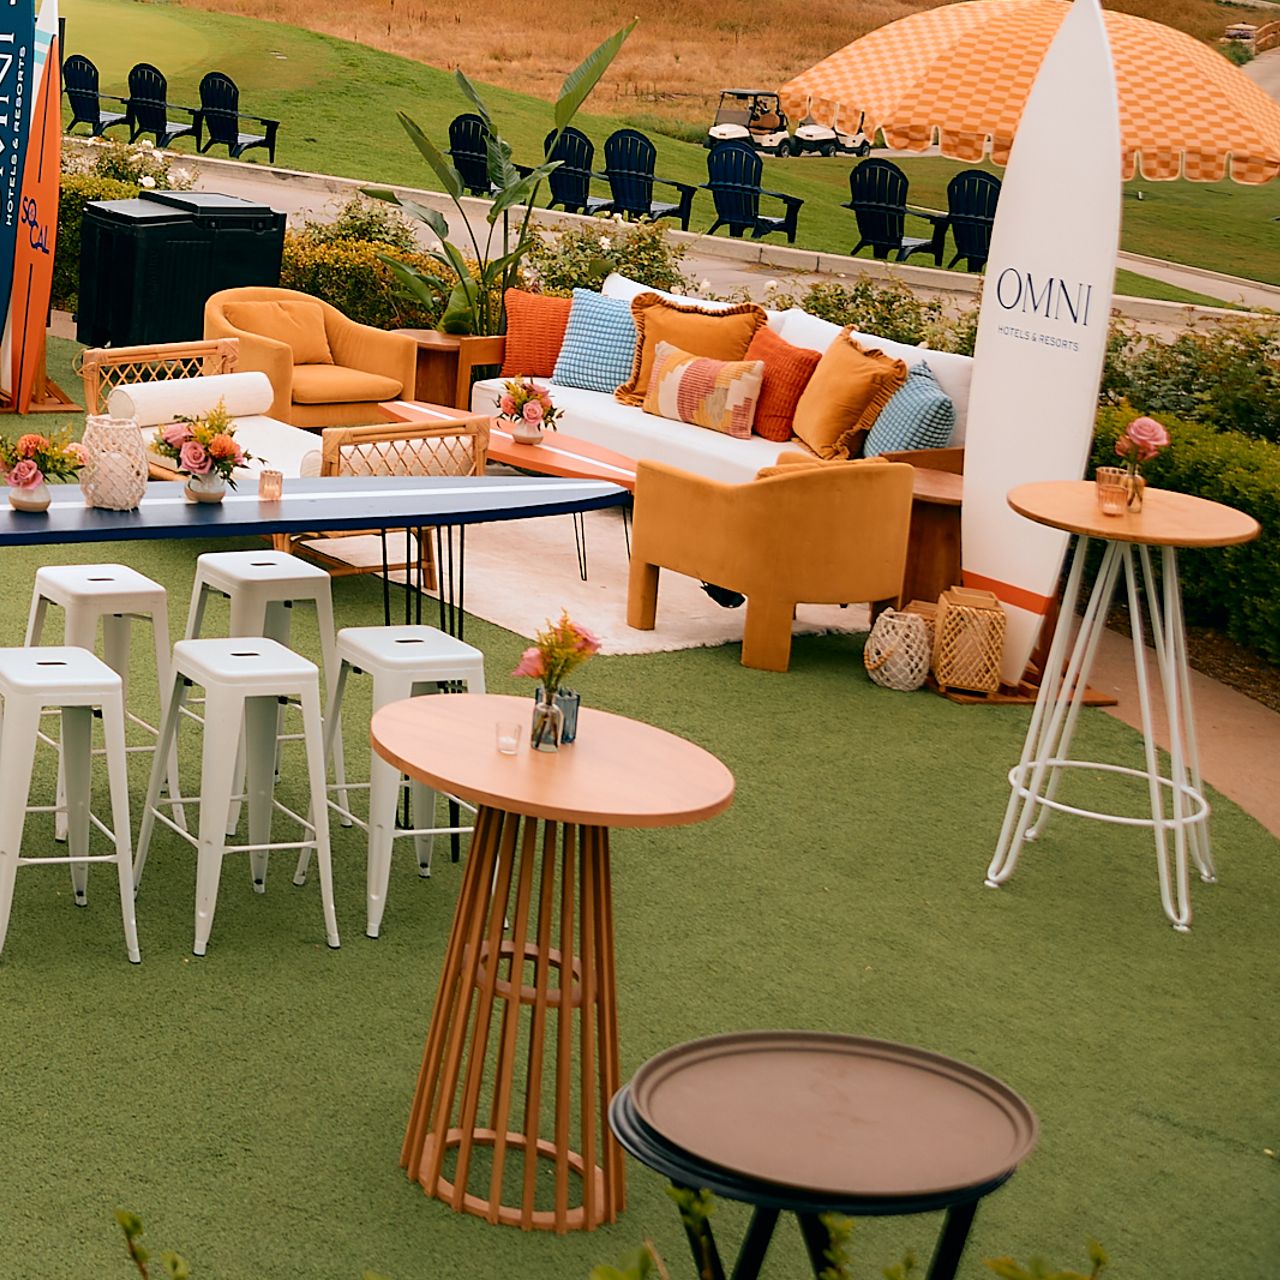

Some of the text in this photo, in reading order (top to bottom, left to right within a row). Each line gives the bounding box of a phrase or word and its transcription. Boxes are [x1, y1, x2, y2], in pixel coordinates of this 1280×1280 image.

[6, 46, 27, 226] HOTELS & RESORTS
[997, 267, 1092, 326] OMNI
[998, 325, 1030, 341] HOTELS
[1038, 334, 1079, 352] RESORTS
